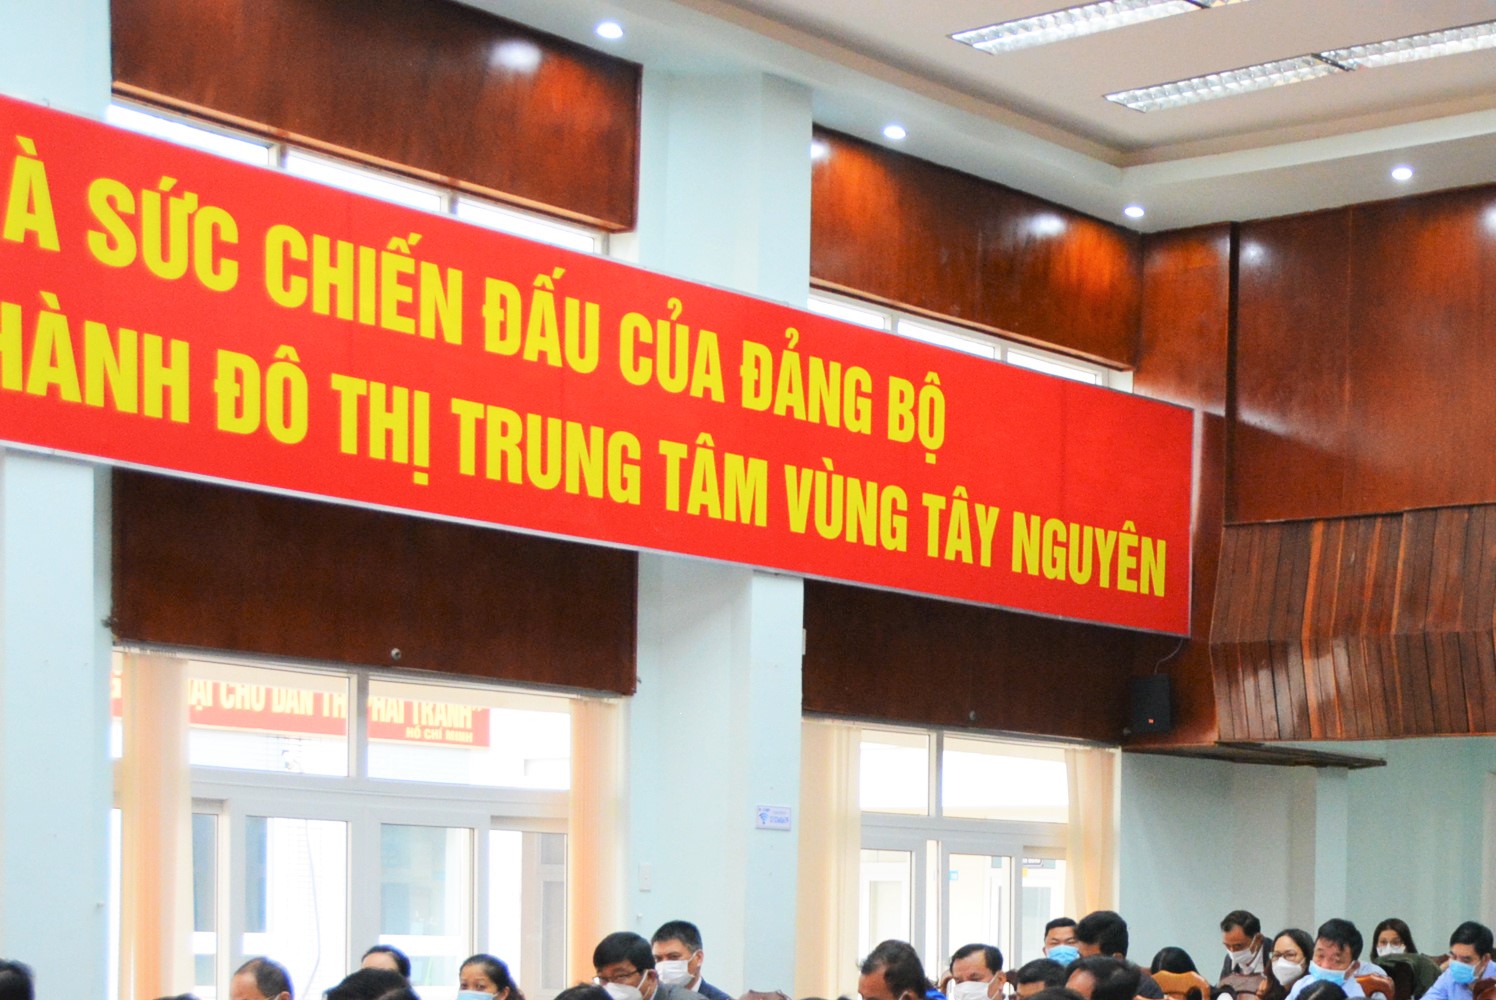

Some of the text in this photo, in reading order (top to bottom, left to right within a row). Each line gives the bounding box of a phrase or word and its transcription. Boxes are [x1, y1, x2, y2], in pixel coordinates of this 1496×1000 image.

[87, 175, 239, 292] SỨC
[265, 224, 463, 345] CHIẾN
[482, 267, 600, 374] ĐẤU
[619, 297, 725, 403] CỦA
[740, 327, 872, 435] ĐẢNG
[888, 371, 945, 464] BỘ
[214, 344, 308, 445] ĐÔ
[331, 373, 430, 486] THỊ
[451, 398, 641, 507] TRUNG
[659, 432, 768, 527] TÂM
[784, 457, 907, 553] VÙNG
[922, 486, 999, 568] TÂY
[1011, 511, 1166, 597] NGUYÊN
